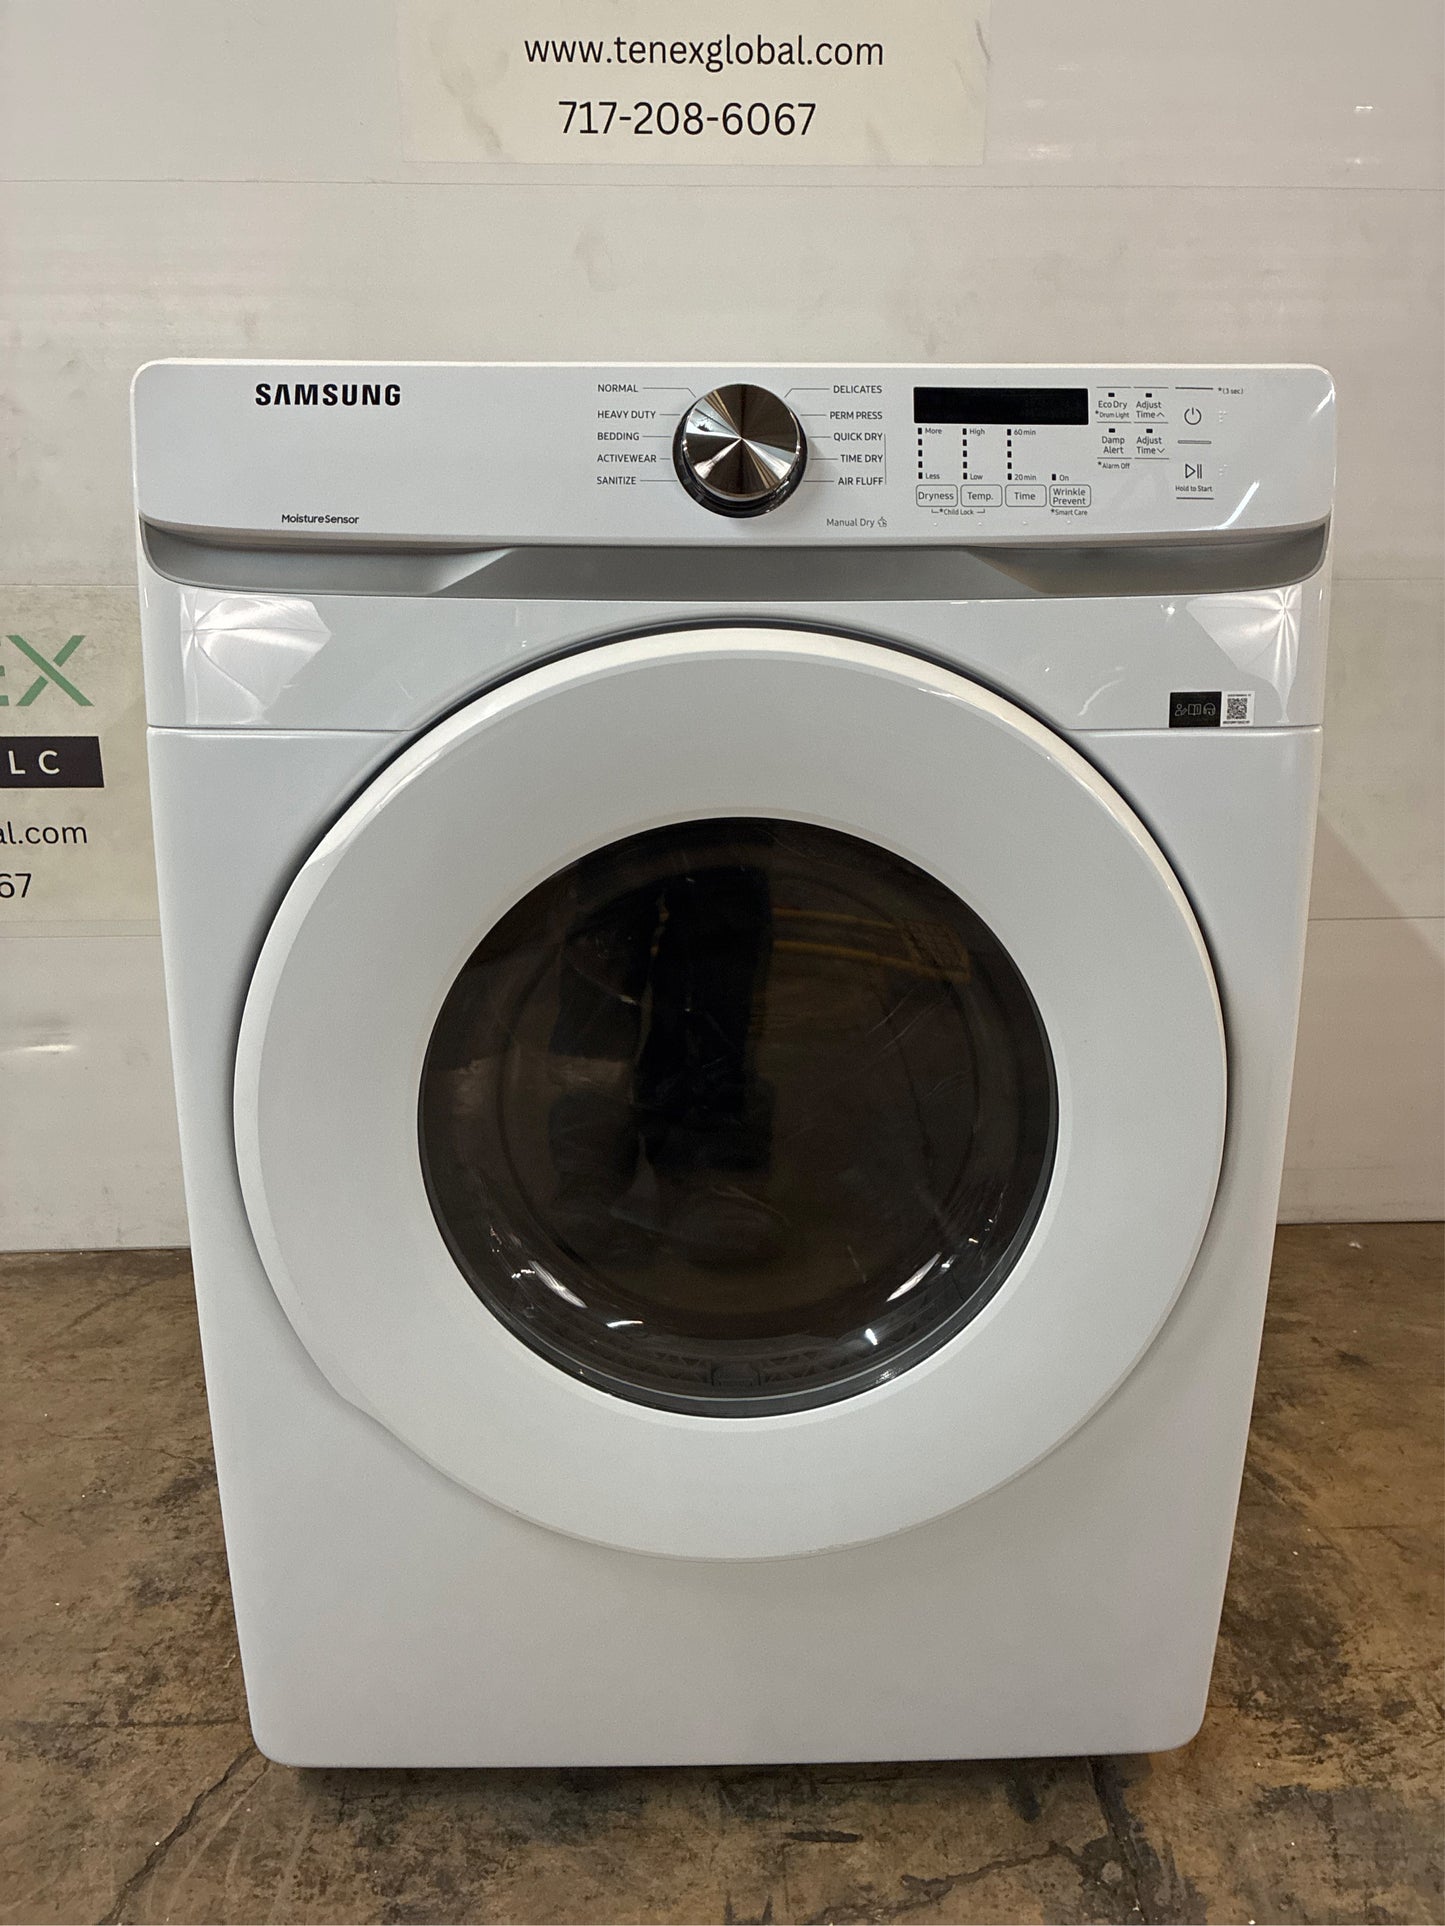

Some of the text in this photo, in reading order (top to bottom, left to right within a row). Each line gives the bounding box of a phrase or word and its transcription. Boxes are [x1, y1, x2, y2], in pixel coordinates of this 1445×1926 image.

[524, 34, 883, 73] www.tenexglobal.com
[559, 101, 816, 136] 717-208-6067
[598, 384, 638, 392] NORMAL
[833, 385, 882, 393] DELICATES
[255, 383, 400, 406] SAMSUNG
[1113, 400, 1127, 410] Dry
[1136, 401, 1162, 410] Adjust
[597, 410, 657, 419] HEAVY DUTY
[830, 411, 883, 420] PERM PRESS
[1115, 411, 1130, 420] Light
[1136, 410, 1155, 418] Time
[597, 432, 639, 440] BEDDING
[969, 428, 985, 436] High
[834, 432, 883, 442] QUICK DRY
[1102, 436, 1125, 445] Damp
[1136, 436, 1162, 446] Adjust
[1103, 446, 1124, 454] Alert
[1136, 446, 1156, 454] Time
[597, 454, 656, 462] ACTIVEWEAR
[840, 454, 884, 463] TIME DRY
[1120, 462, 1131, 470] Off
[597, 476, 636, 485] SANITIZE
[970, 472, 983, 480] Low
[837, 477, 884, 486] AIR FLUFF
[918, 491, 954, 502] Dryness
[967, 491, 994, 502] Temp.
[1014, 492, 1036, 500] Time
[1053, 487, 1086, 497] Wrinkle
[1052, 496, 1086, 506] Prevent
[958, 508, 974, 516] Lock
[1074, 508, 1088, 516] Care
[827, 518, 875, 528] Manual Dry
